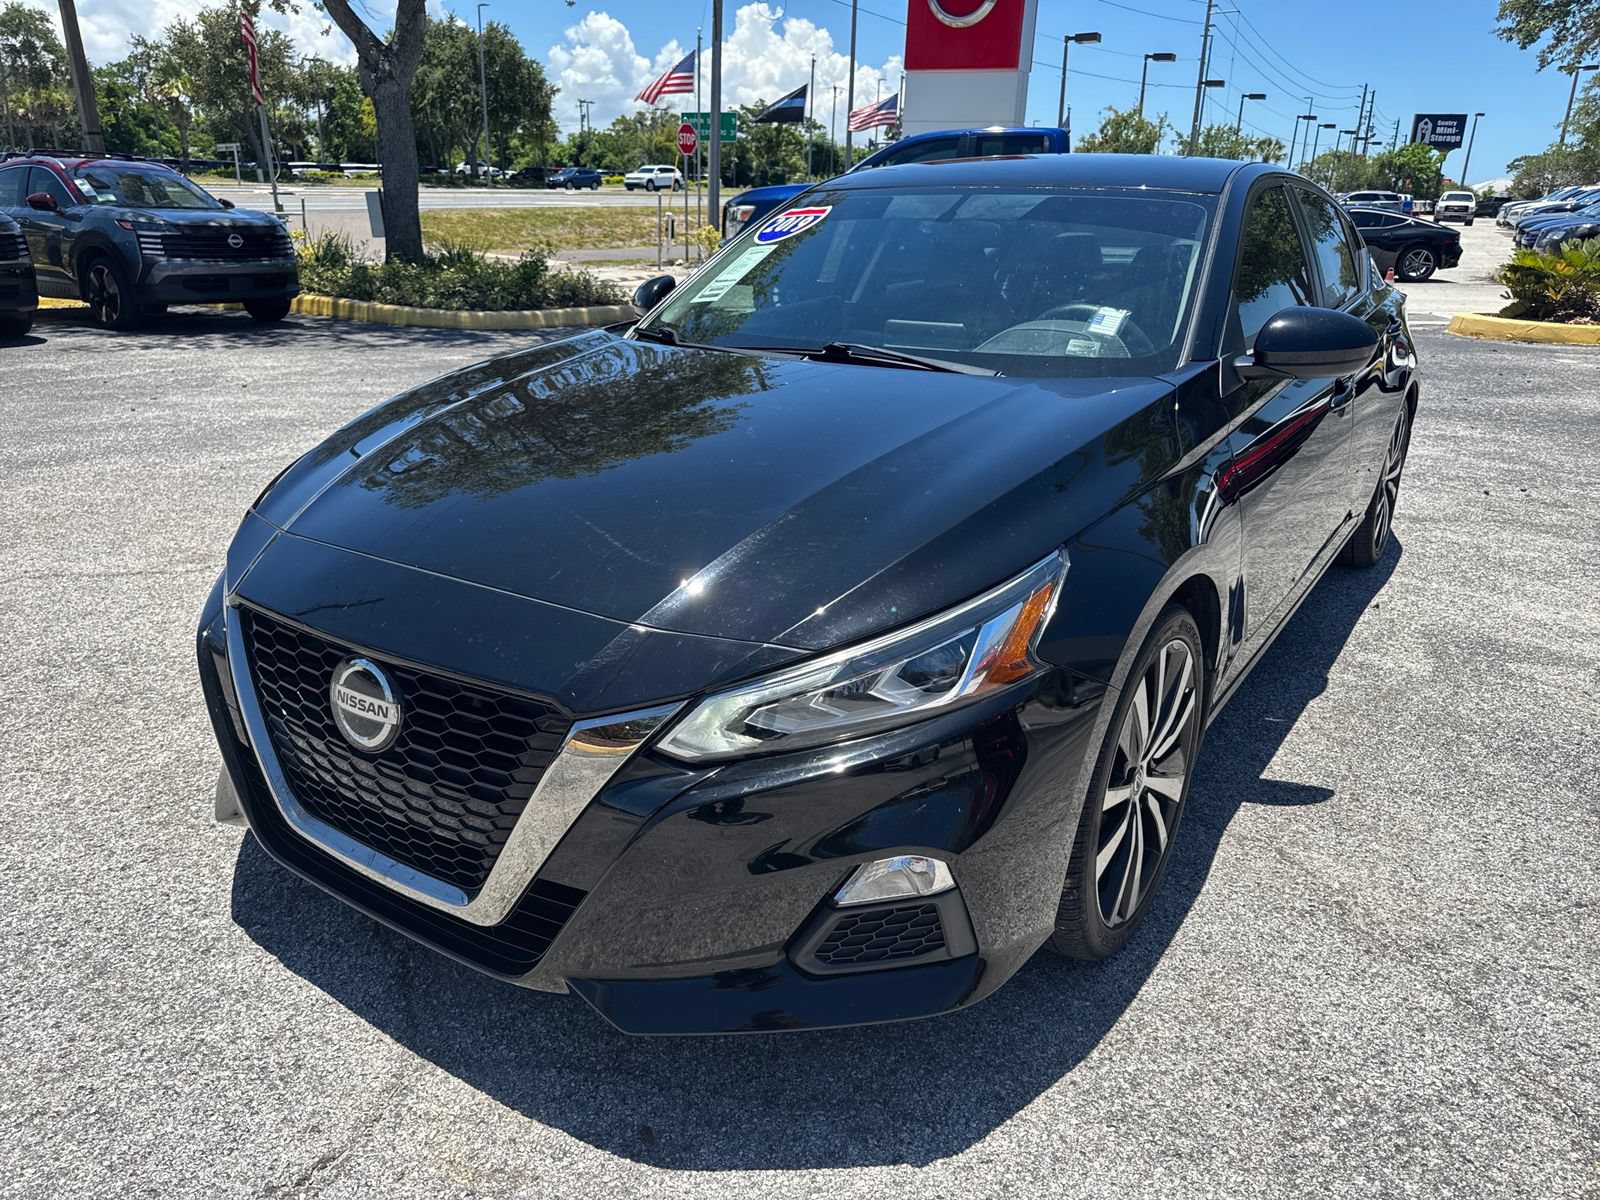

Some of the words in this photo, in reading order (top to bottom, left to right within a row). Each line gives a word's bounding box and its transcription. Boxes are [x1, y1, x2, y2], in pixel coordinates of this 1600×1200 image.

[679, 133, 696, 145] STOP
[1431, 134, 1460, 142] Storage
[763, 215, 814, 232] 2019
[337, 689, 389, 719] NISSAN
